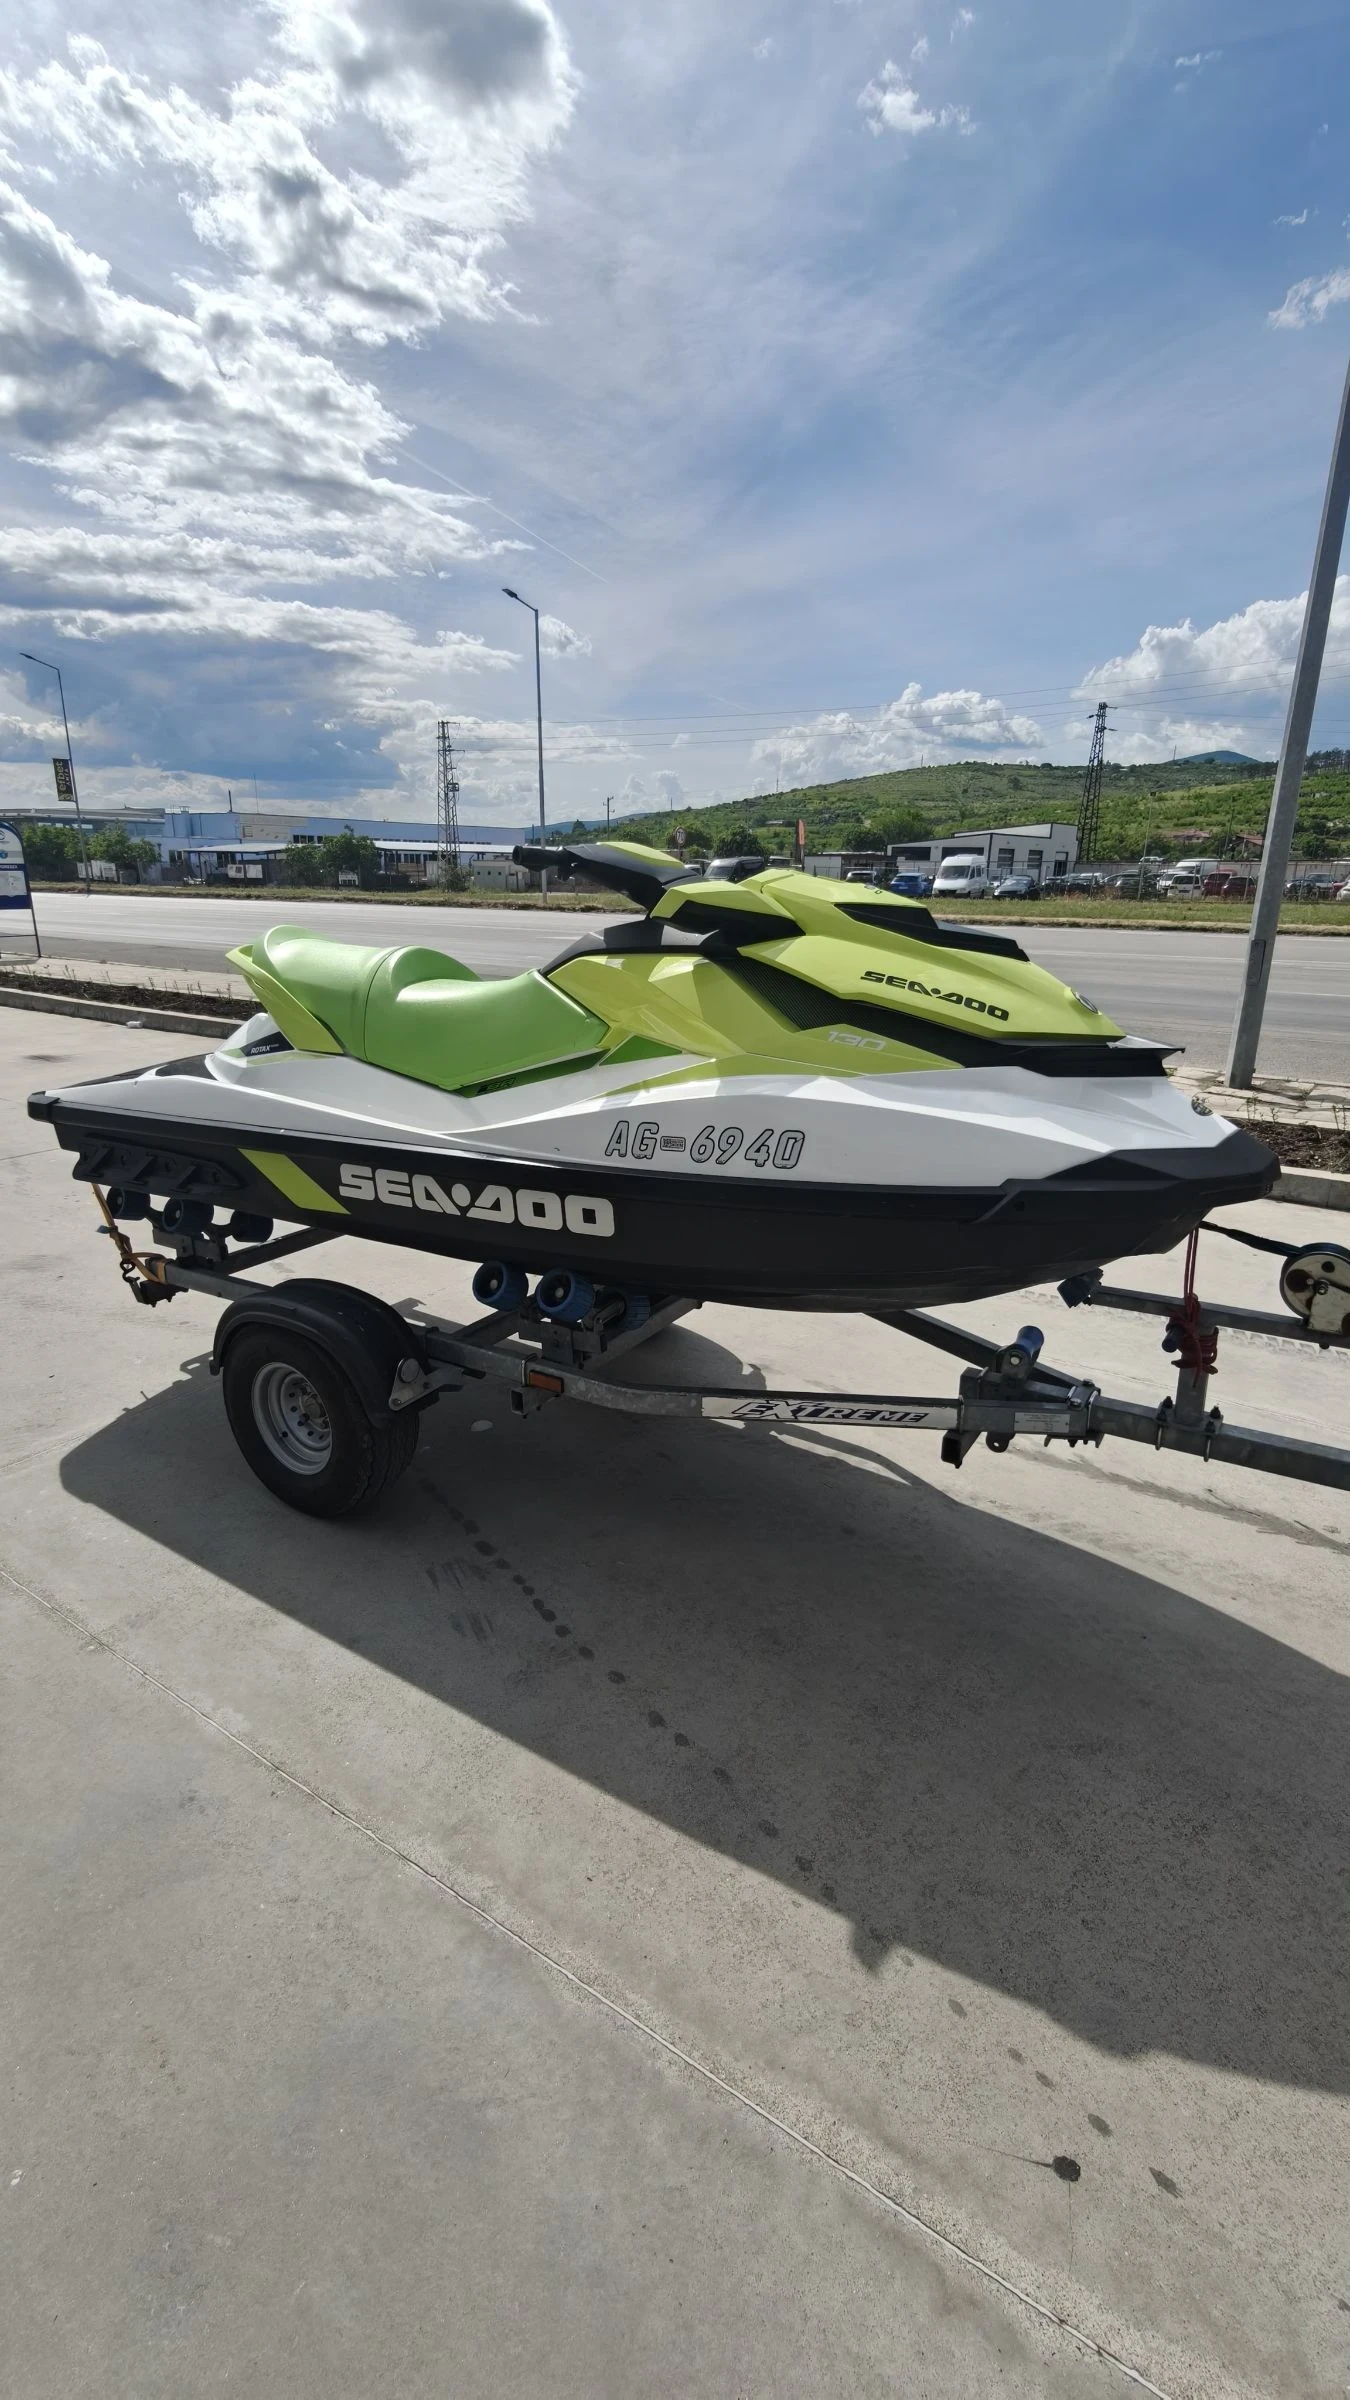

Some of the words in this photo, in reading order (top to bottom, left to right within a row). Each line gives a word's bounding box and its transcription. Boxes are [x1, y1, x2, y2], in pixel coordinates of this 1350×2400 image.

[250, 1045, 271, 1054] ROTAX
[827, 1031, 887, 1051] 130
[604, 1120, 806, 1170] AG-6940
[731, 1400, 930, 1424] EXTREME
